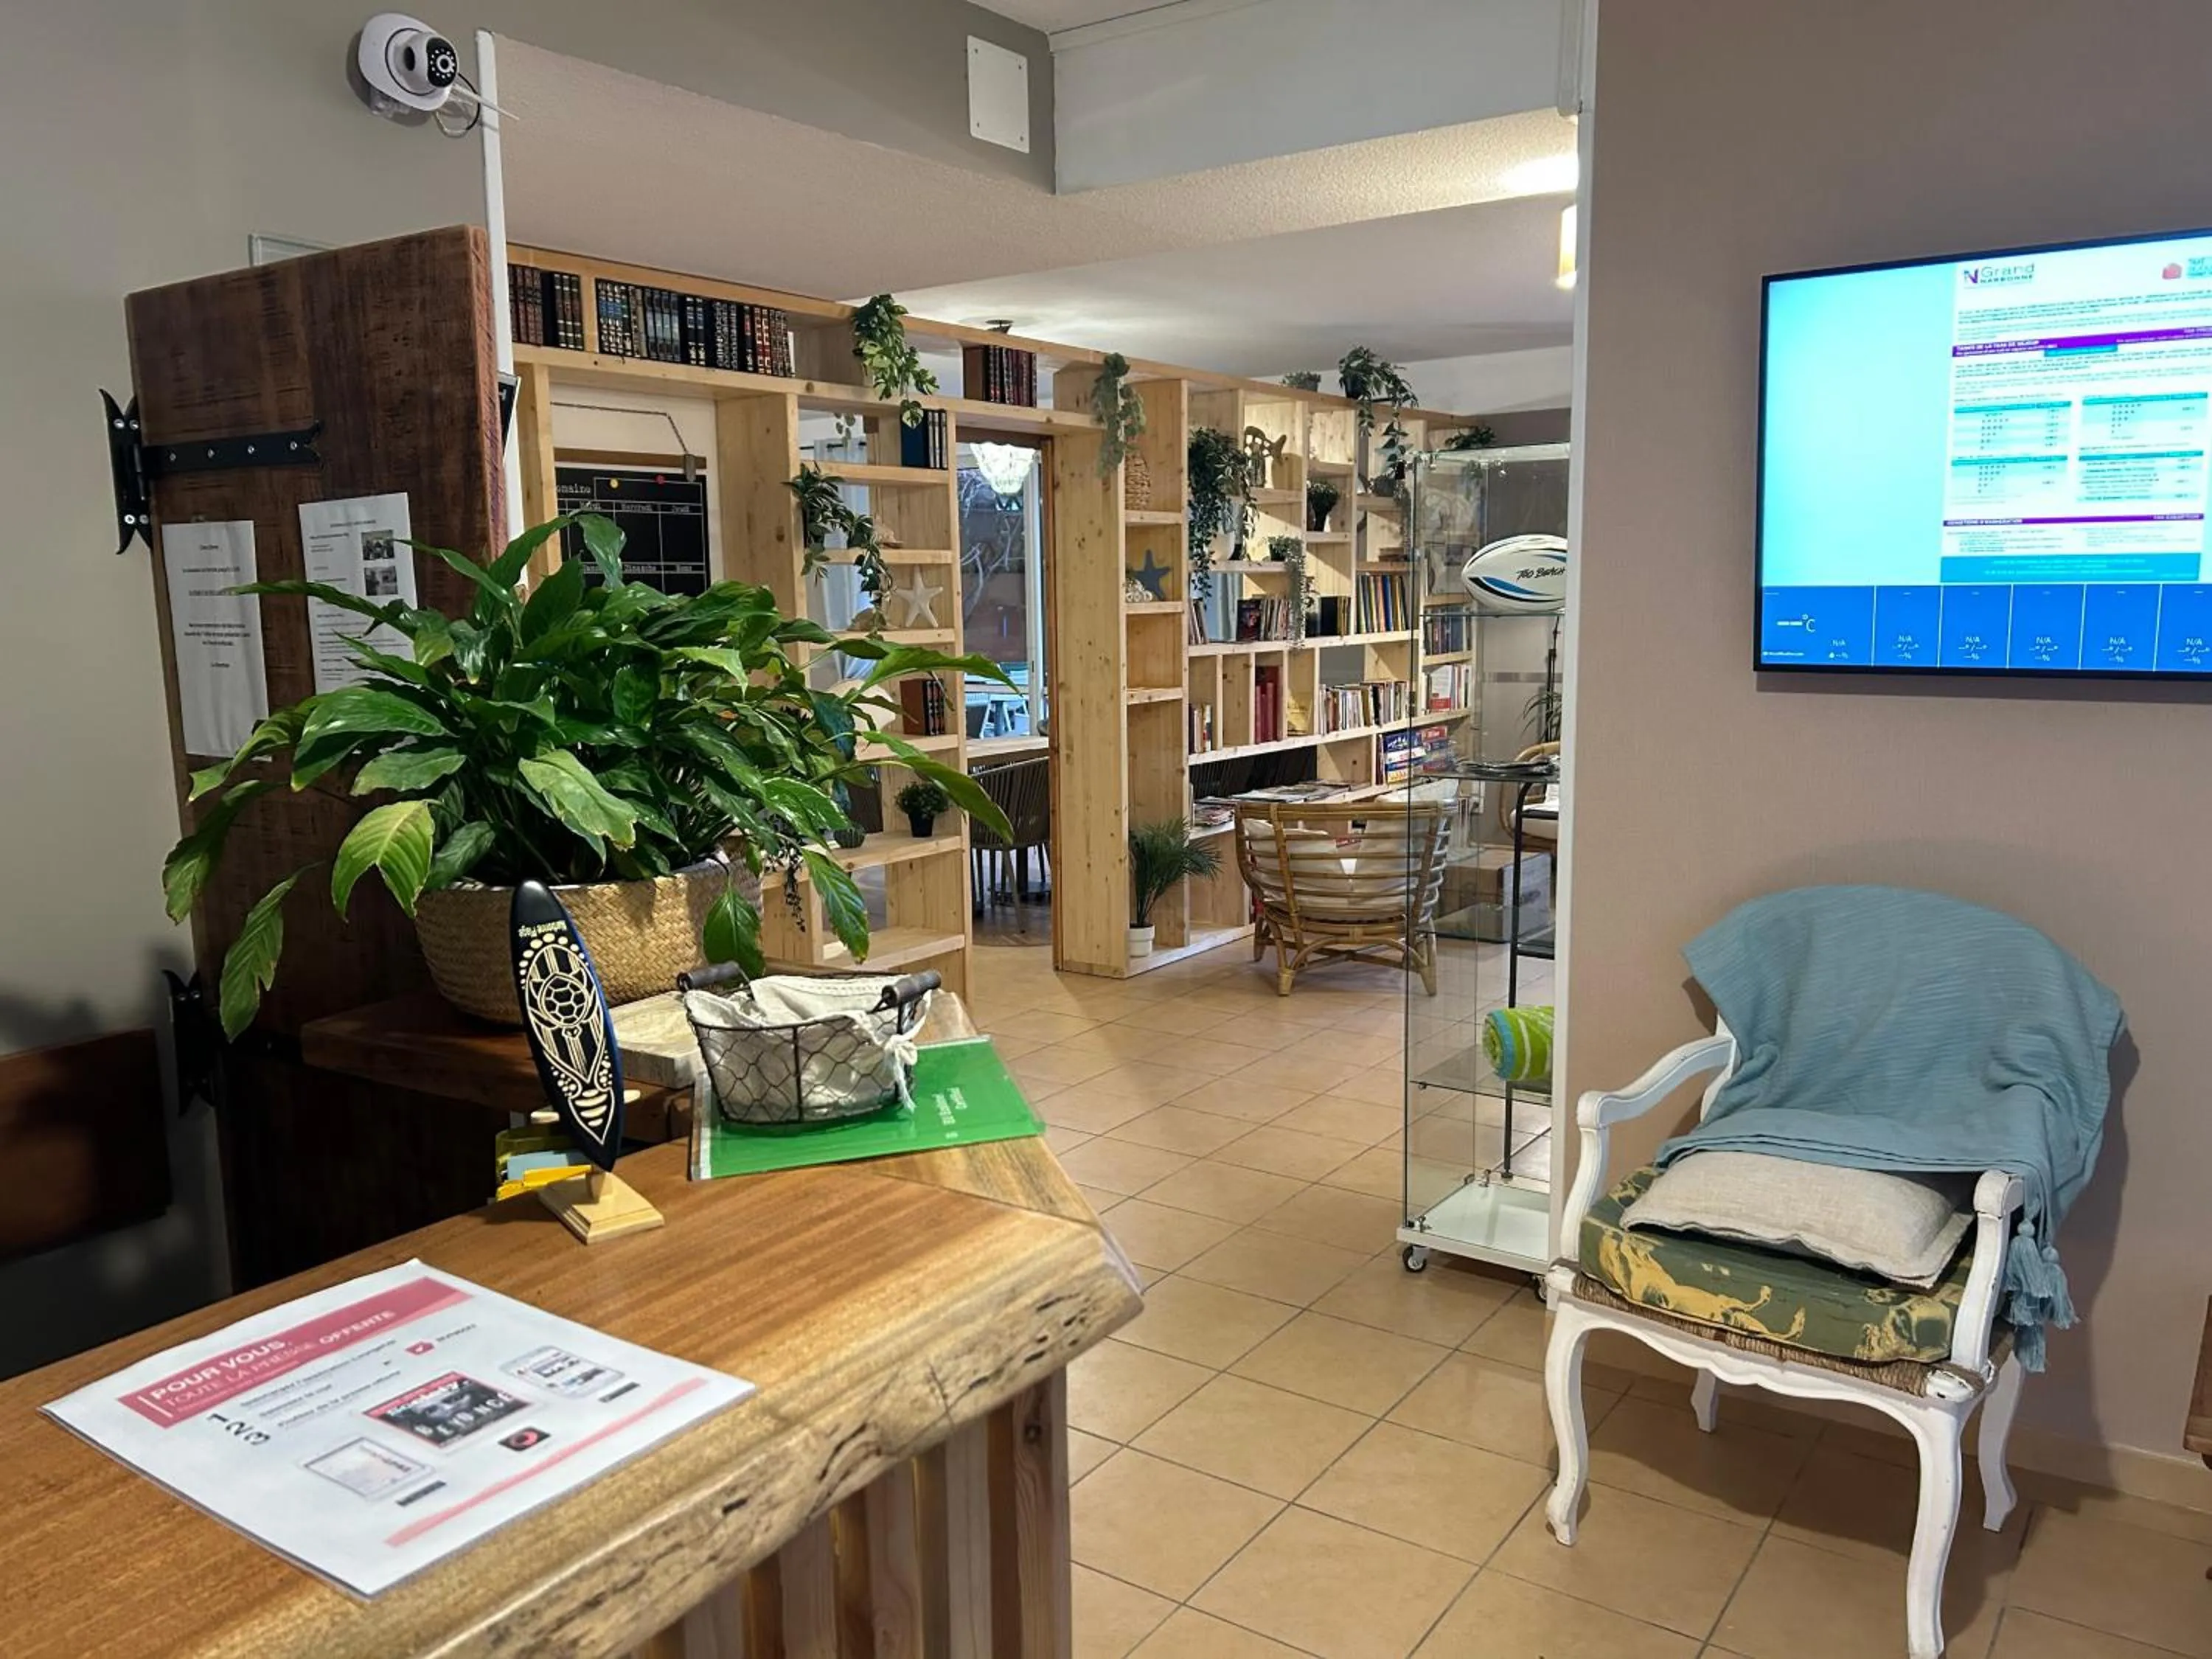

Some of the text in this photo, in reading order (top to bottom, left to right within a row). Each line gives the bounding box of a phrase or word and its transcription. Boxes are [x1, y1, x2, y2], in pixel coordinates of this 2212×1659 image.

[1980, 263, 2035, 279] Grand
[1980, 274, 2034, 285] NARBONNE
[556, 484, 591, 494] emaine
[518, 920, 567, 938] Narbonne Plage
[164, 1380, 223, 1408] TOUTE
[224, 1368, 249, 1384] LA
[318, 1310, 397, 1346] OFFERTE
[150, 1366, 221, 1401] POUR
[206, 1413, 228, 1425] 1
[224, 1420, 251, 1436] 2
[243, 1431, 272, 1447] 3
